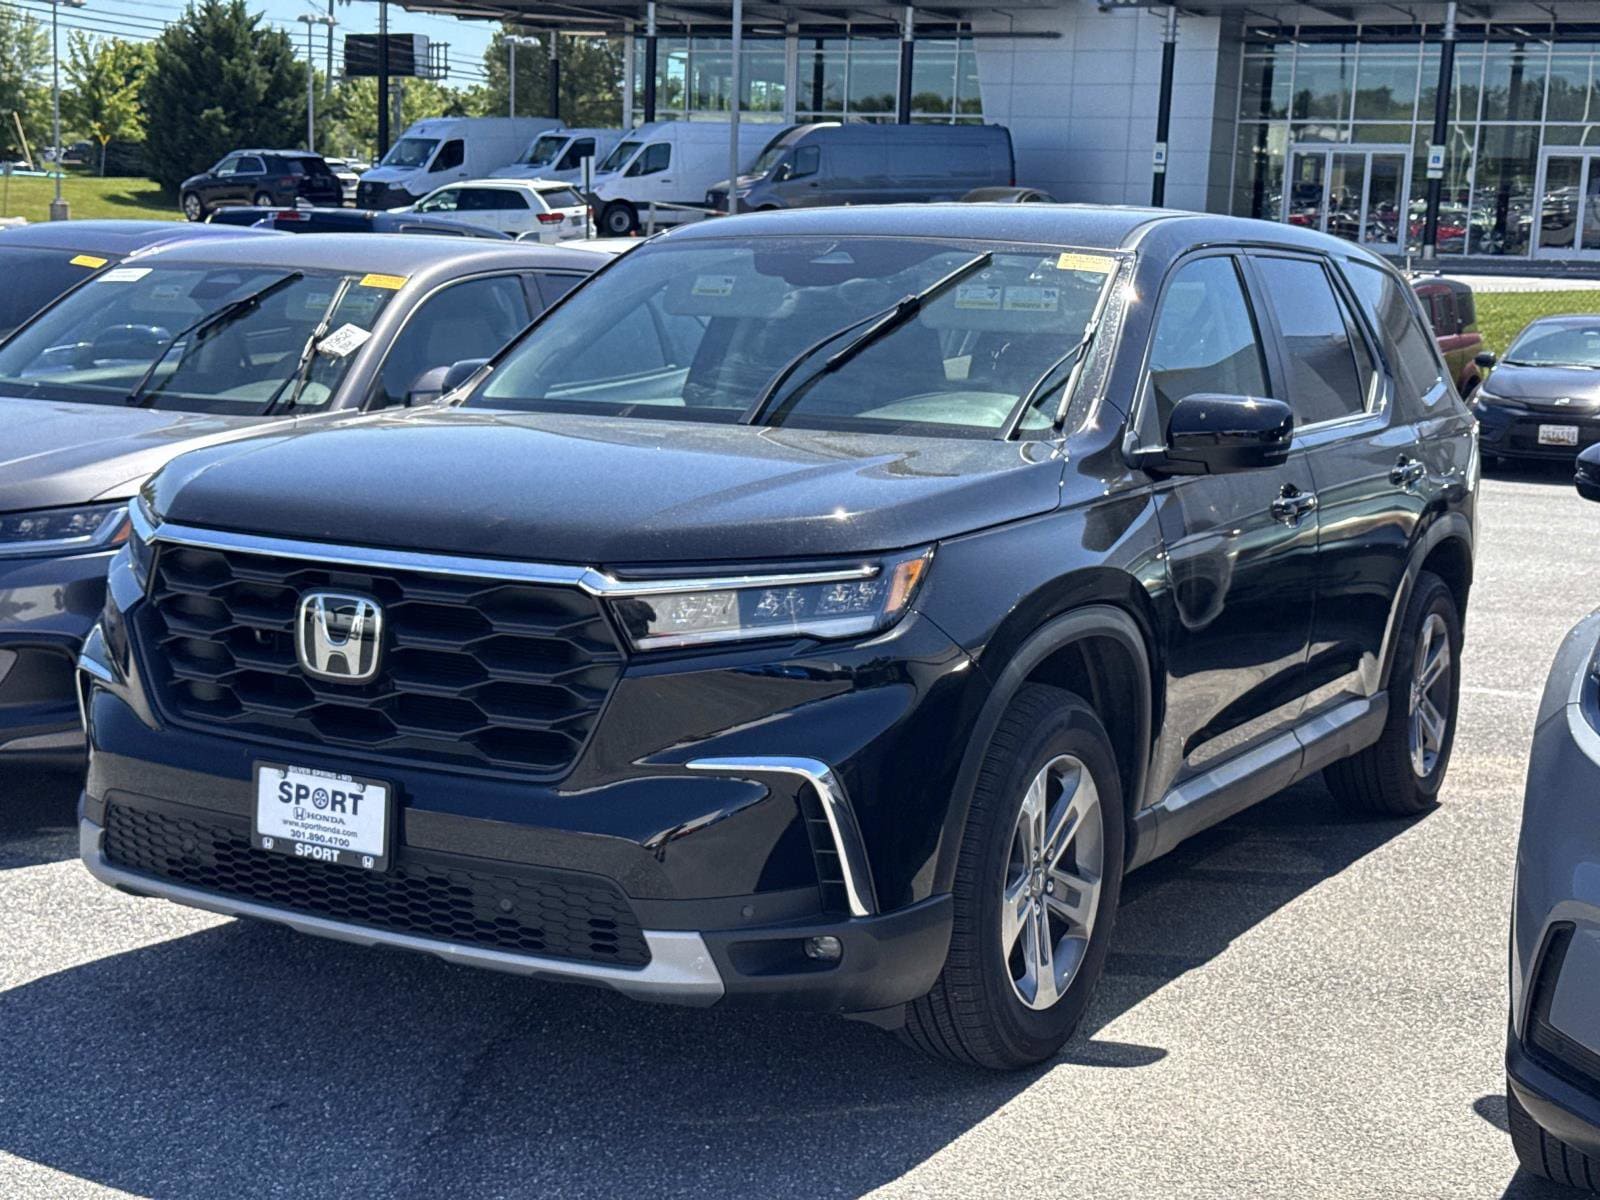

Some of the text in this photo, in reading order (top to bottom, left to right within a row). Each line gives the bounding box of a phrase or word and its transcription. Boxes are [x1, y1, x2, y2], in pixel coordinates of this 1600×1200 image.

[278, 781, 364, 816] SPORT
[307, 811, 346, 825] HONDA
[282, 819, 358, 838] www.sporthonda.com
[290, 829, 350, 847] 301.890.4700
[295, 843, 340, 862] SPORT
